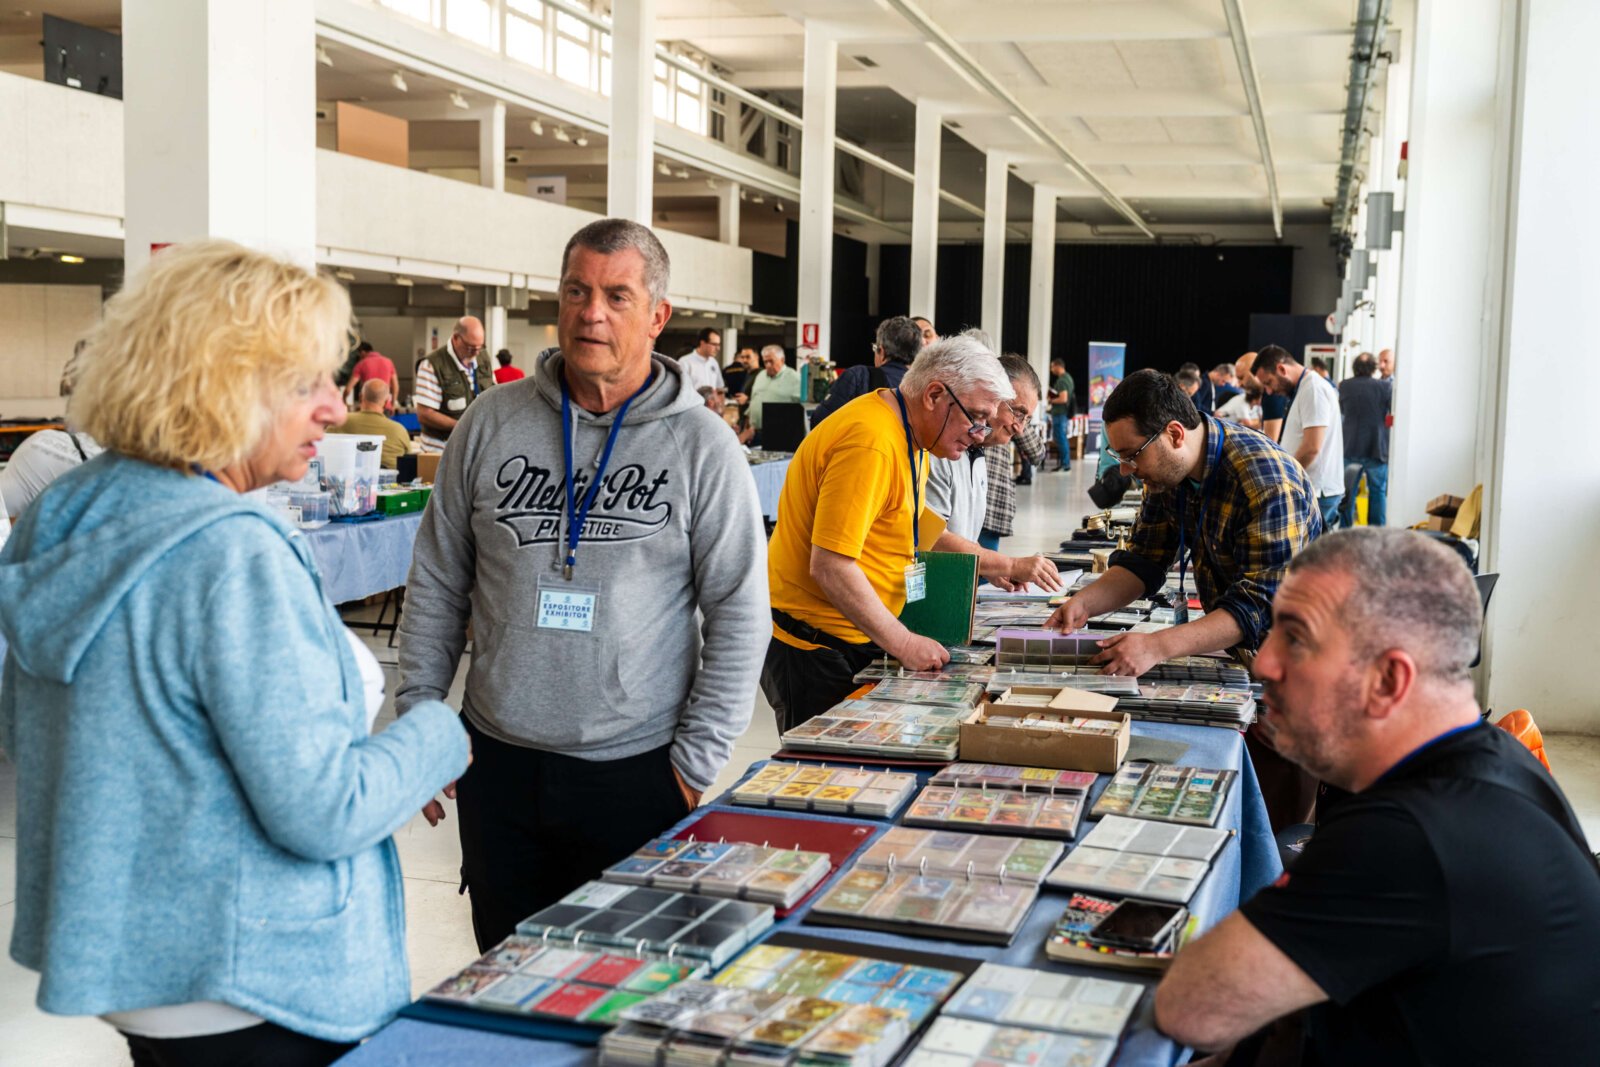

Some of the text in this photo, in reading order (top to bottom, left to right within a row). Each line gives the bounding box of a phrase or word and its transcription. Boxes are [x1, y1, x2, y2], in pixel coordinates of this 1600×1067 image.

[603, 464, 669, 512] Pot
[543, 602, 591, 612] ESPOSITORE
[545, 609, 588, 619] EXHIBITOR
